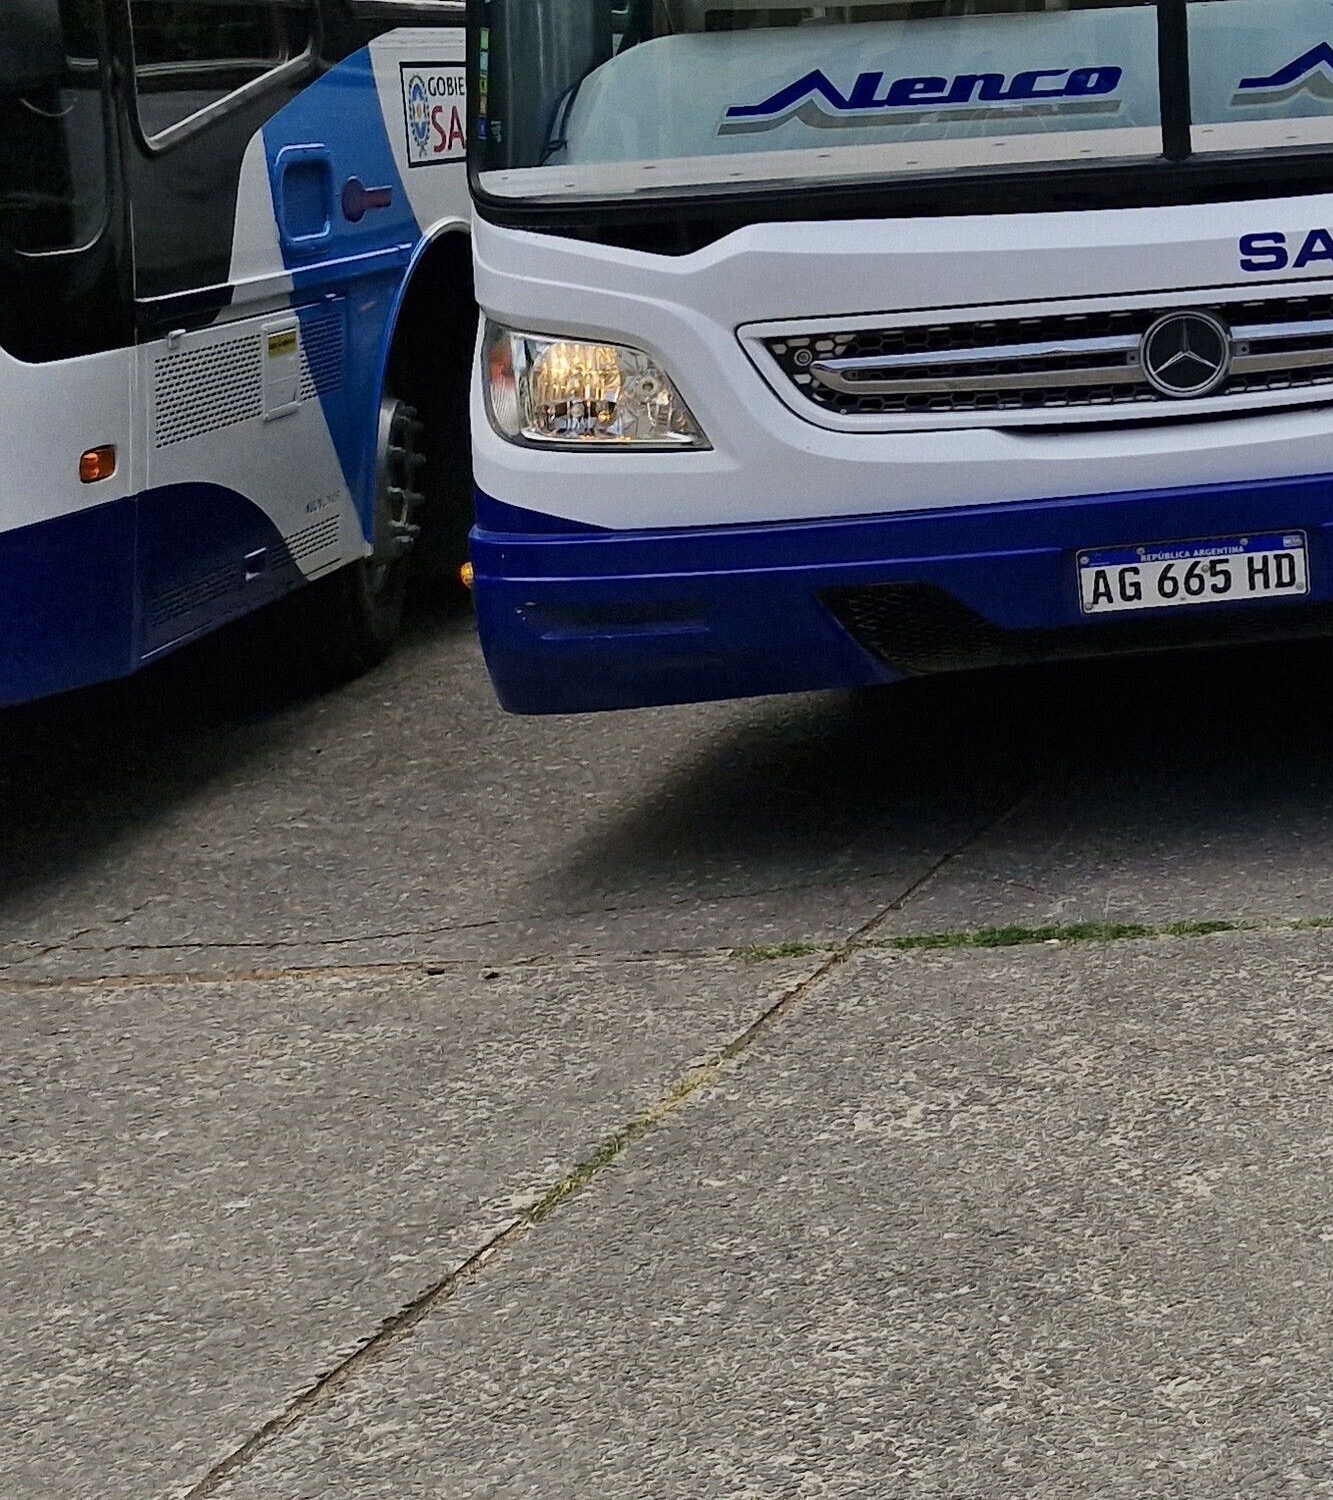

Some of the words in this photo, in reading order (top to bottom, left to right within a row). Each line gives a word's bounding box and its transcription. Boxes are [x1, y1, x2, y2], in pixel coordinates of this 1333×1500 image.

[726, 65, 1123, 118] Alenco
[1193, 545, 1245, 558] ARGENTINA
[1092, 566, 1142, 605] AG
[1157, 558, 1232, 599] 665
[1247, 553, 1297, 591] HD
